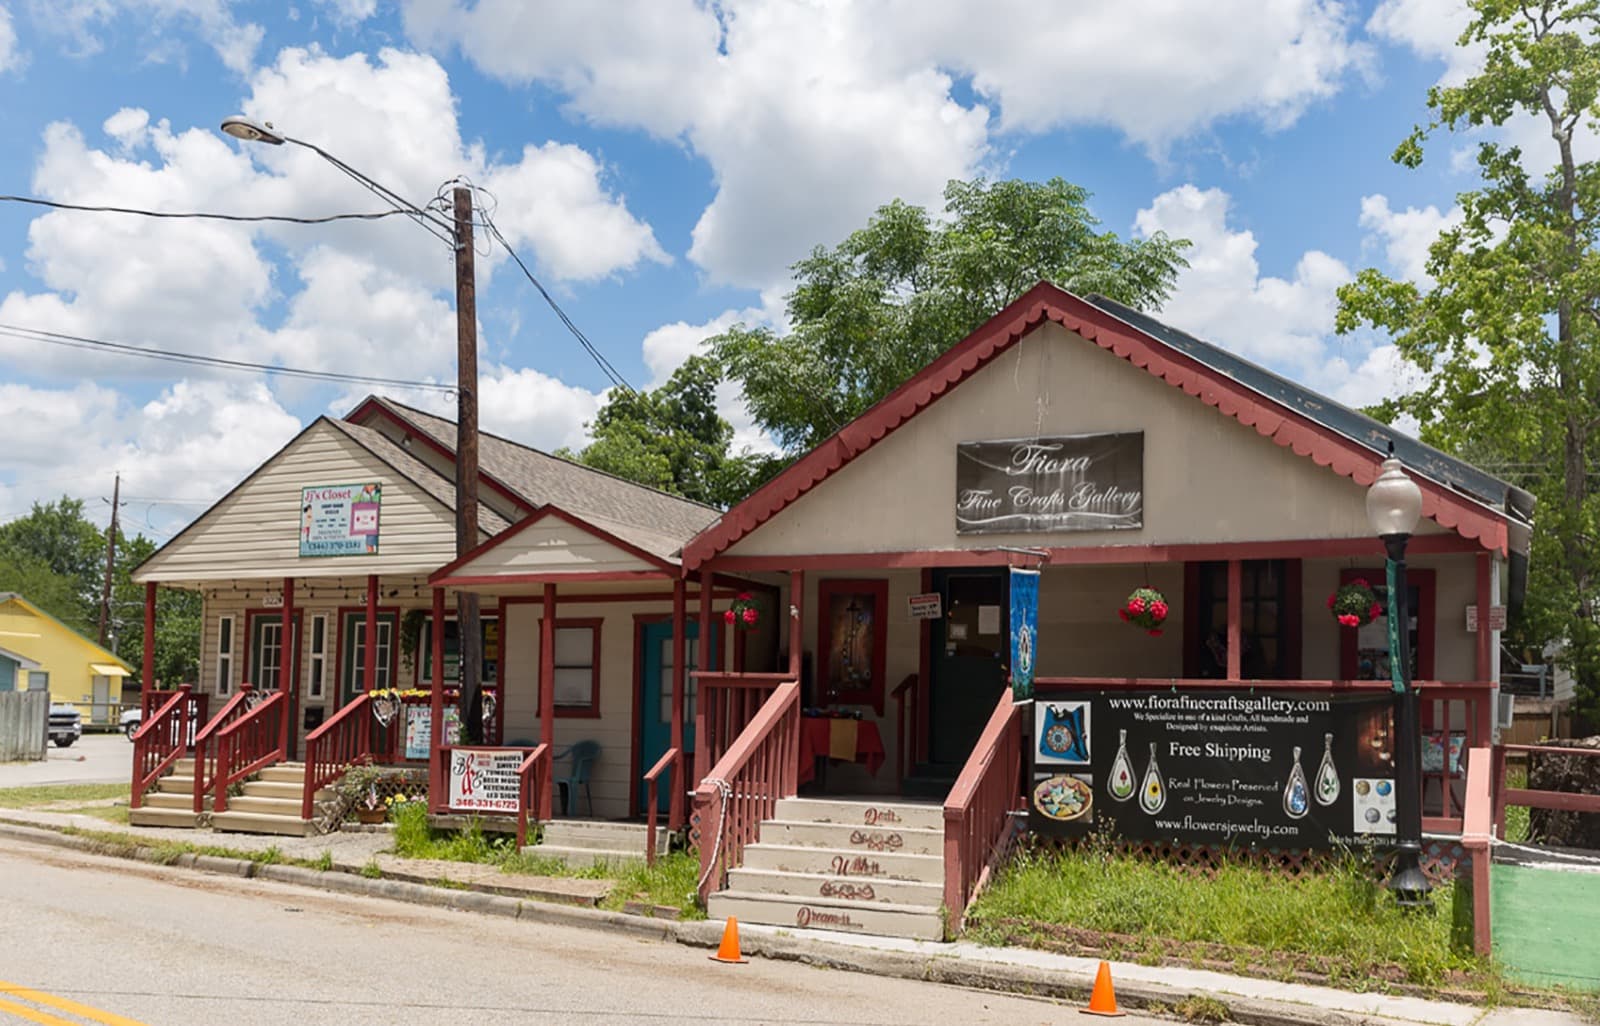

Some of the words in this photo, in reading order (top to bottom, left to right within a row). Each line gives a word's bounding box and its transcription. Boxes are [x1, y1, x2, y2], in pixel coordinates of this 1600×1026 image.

[1006, 443, 1092, 475] Fiora
[322, 489, 351, 500] Closet
[957, 489, 1002, 510] Fine
[1008, 485, 1065, 513] Crafts
[1068, 481, 1141, 511] Gallery
[1109, 695, 1330, 714] www.fiorafinecraftsgallery.com
[1133, 712, 1145, 721] We
[1211, 712, 1226, 722] kind
[1250, 713, 1261, 722] All
[1261, 714, 1295, 723] handmade
[1296, 714, 1309, 723] and
[1166, 722, 1198, 733] Designed
[1199, 723, 1208, 733] by
[1209, 723, 1241, 733] exquisite
[1169, 742, 1201, 757] Free
[1205, 742, 1272, 762] Shipping
[1168, 777, 1191, 789] Real
[1194, 778, 1230, 790] Flowers
[1231, 779, 1279, 792] Preserved
[1194, 793, 1227, 807] Jewelry
[1155, 815, 1299, 840] www.flowersjewelry.com
